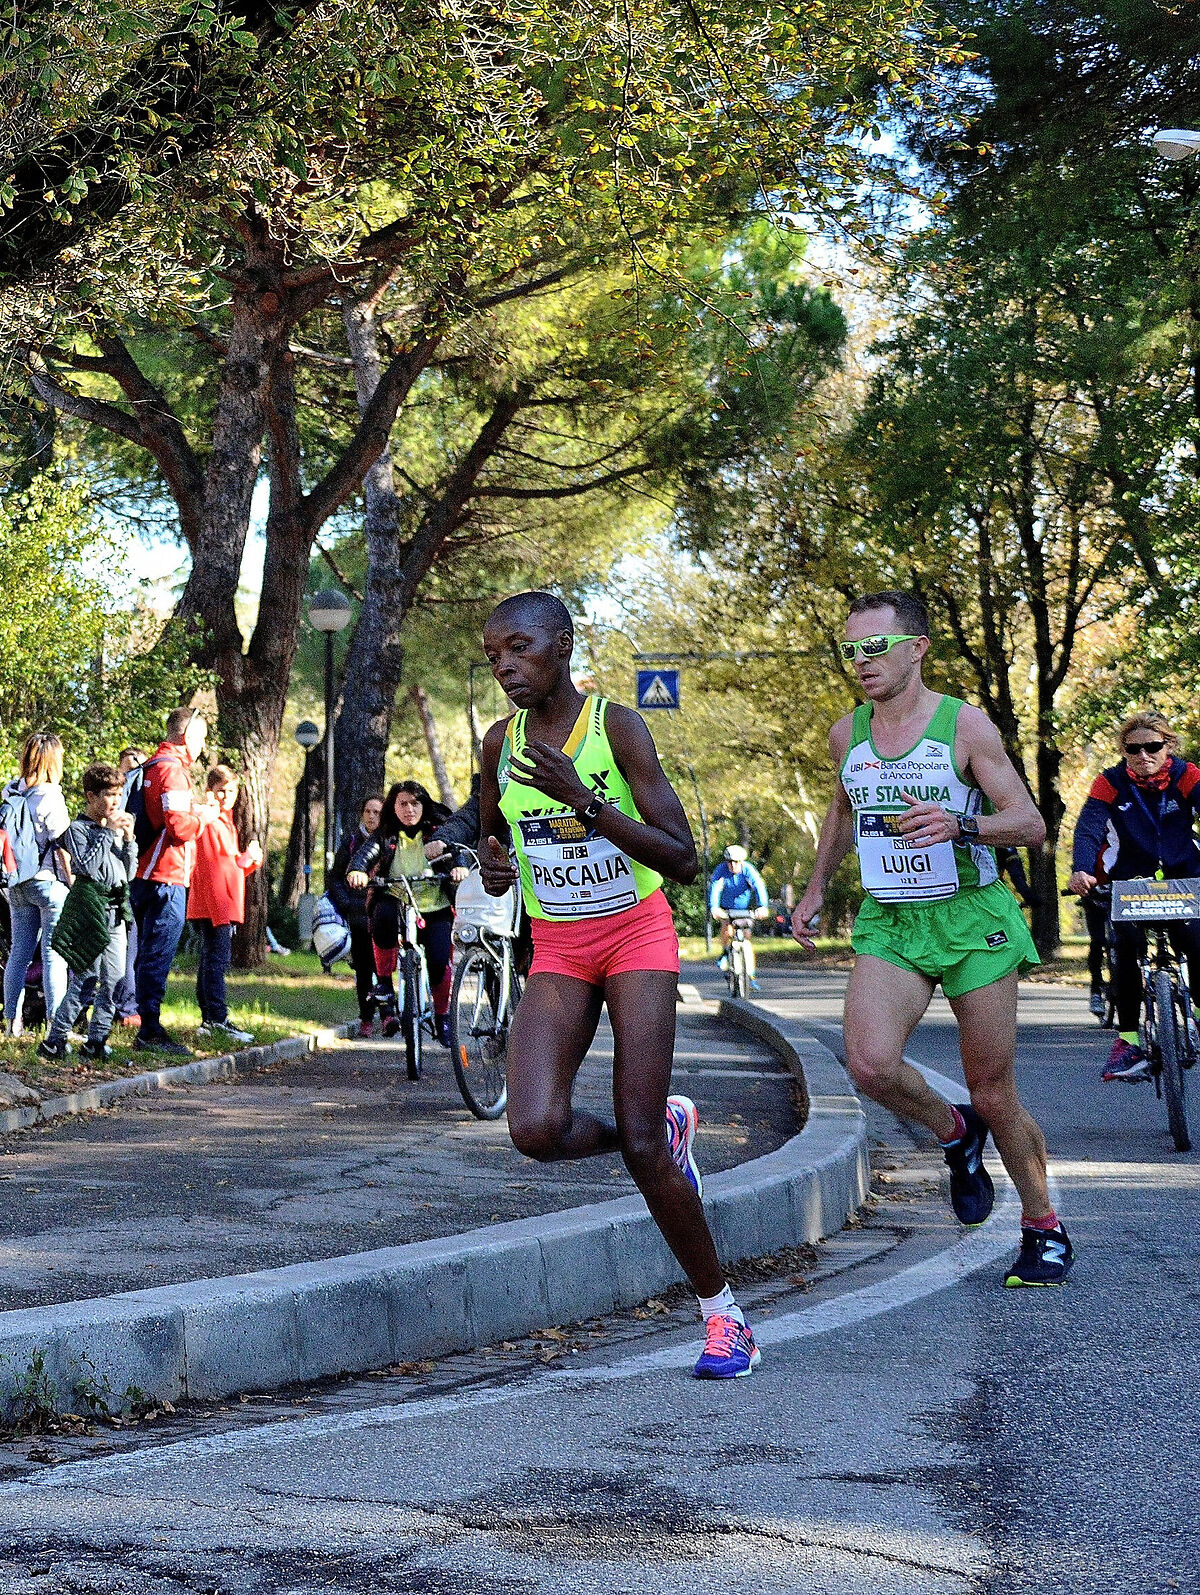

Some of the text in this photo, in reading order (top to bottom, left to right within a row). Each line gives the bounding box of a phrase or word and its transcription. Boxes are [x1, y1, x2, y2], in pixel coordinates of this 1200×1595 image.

[850, 760, 949, 773] UBI Banca Popolare
[880, 771, 923, 780] di Ancona
[849, 785, 951, 804] SEF STAMURA
[548, 817, 583, 828] MARATON
[881, 853, 932, 874] LUIGI
[531, 855, 630, 888] PASCALIA
[1120, 893, 1196, 902] MARATONA
[1121, 907, 1194, 916] ASSOLUTA
